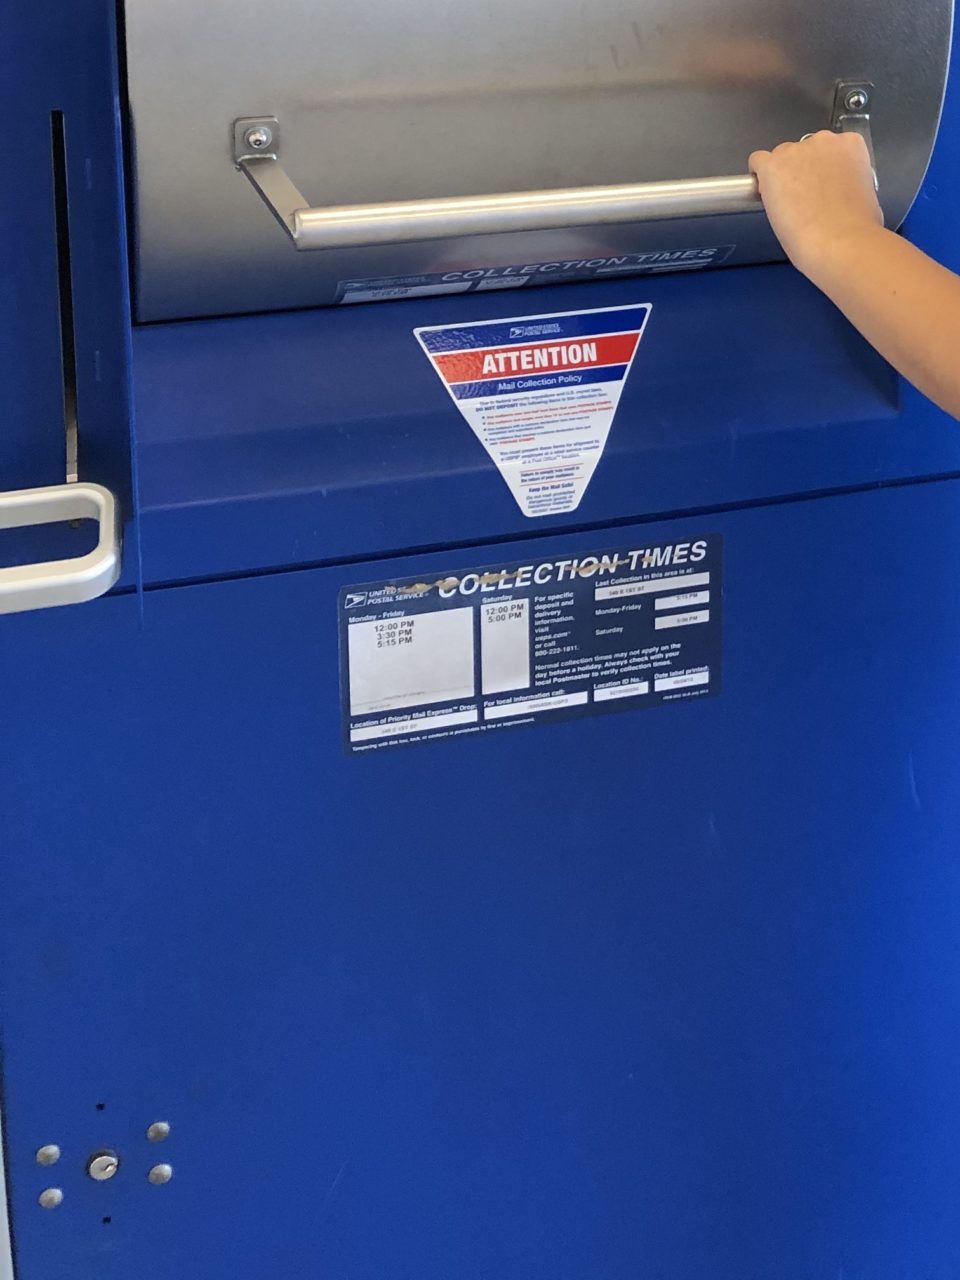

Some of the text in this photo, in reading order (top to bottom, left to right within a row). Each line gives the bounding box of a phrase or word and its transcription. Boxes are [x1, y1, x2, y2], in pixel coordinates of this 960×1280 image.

[441, 256, 627, 282] COLLECTION
[637, 247, 718, 264] TIMES
[482, 342, 598, 375] ATTENTION
[498, 374, 582, 392] Mail Collection Policy
[438, 540, 708, 599] COLLECTION TIMES
[610, 576, 643, 586] Collection
[482, 594, 512, 604] Saturday
[548, 592, 574, 601] specific
[486, 604, 524, 616] 12:00 PM
[534, 602, 560, 611] deposit
[348, 610, 405, 624] Monday Friday
[488, 612, 522, 624] 5:00 PM
[534, 610, 562, 618] delivery
[374, 620, 415, 632] 12:00 PM
[595, 626, 624, 636] Saturday
[376, 628, 412, 640] 3:30 PM
[376, 636, 412, 648] 5:15 PM
[534, 662, 560, 672] Normal
[560, 656, 594, 667] collection
[614, 652, 628, 660] may
[642, 646, 660, 655] apply
[534, 672, 548, 680] day
[548, 667, 571, 677] before
[604, 658, 628, 669] Always
[629, 654, 650, 664] check
[650, 652, 664, 660] with
[665, 650, 680, 658] your
[534, 678, 552, 687] local
[552, 672, 591, 684] Postmaster
[600, 666, 619, 677] verify
[620, 662, 652, 673] collection
[654, 671, 668, 680] Date
[669, 668, 684, 677] label
[594, 680, 621, 690] Location
[484, 698, 494, 708] For
[496, 696, 512, 706] local
[514, 690, 550, 704] information
[350, 719, 379, 730] Location
[388, 714, 412, 724] Priority
[412, 712, 426, 720] Mail
